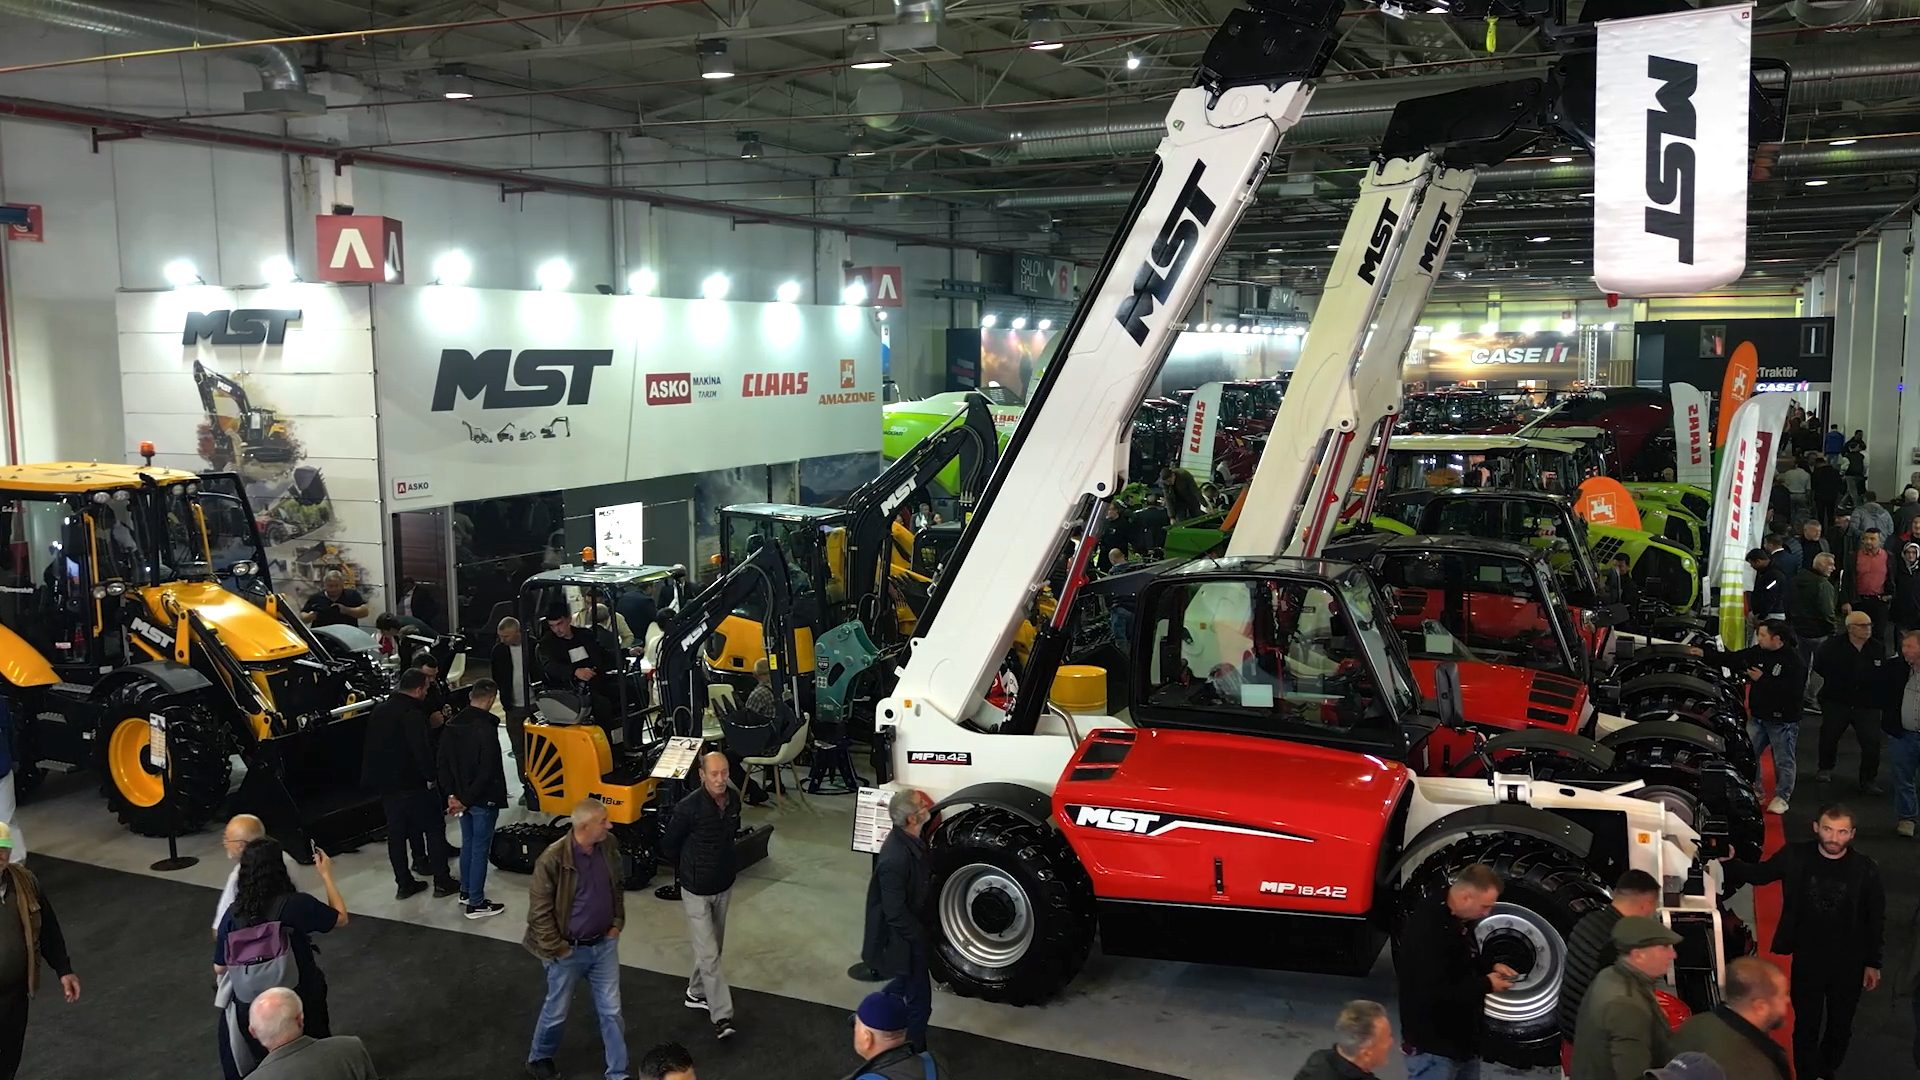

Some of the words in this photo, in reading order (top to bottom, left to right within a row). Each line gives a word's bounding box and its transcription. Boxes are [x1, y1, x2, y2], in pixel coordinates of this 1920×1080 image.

[1645, 54, 1698, 265] MST
[1115, 158, 1217, 346] MST
[1357, 197, 1400, 286] MST
[1419, 201, 1453, 273] MST
[1020, 258, 1044, 277] SALON
[1058, 264, 1068, 295] 6
[1020, 275, 1038, 293] HALL
[182, 309, 302, 345] MST
[1471, 347, 1543, 364] CASE
[431, 349, 614, 412] MST
[649, 379, 690, 399] ASKO
[742, 372, 809, 398] CLAAS
[1756, 383, 1794, 392] CASE
[818, 391, 876, 406] AMAZONE
[1189, 400, 1207, 453] CLAAS
[408, 482, 429, 491] ASKO
[880, 474, 918, 517] MST
[1730, 438, 1747, 541] CLAAS
[130, 616, 175, 648] MST
[680, 622, 708, 652] MST
[911, 752, 934, 761] MP
[935, 753, 968, 762] 18.42
[1075, 806, 1160, 834] MST
[1260, 880, 1296, 894] MP
[1297, 884, 1347, 898] 18.42
